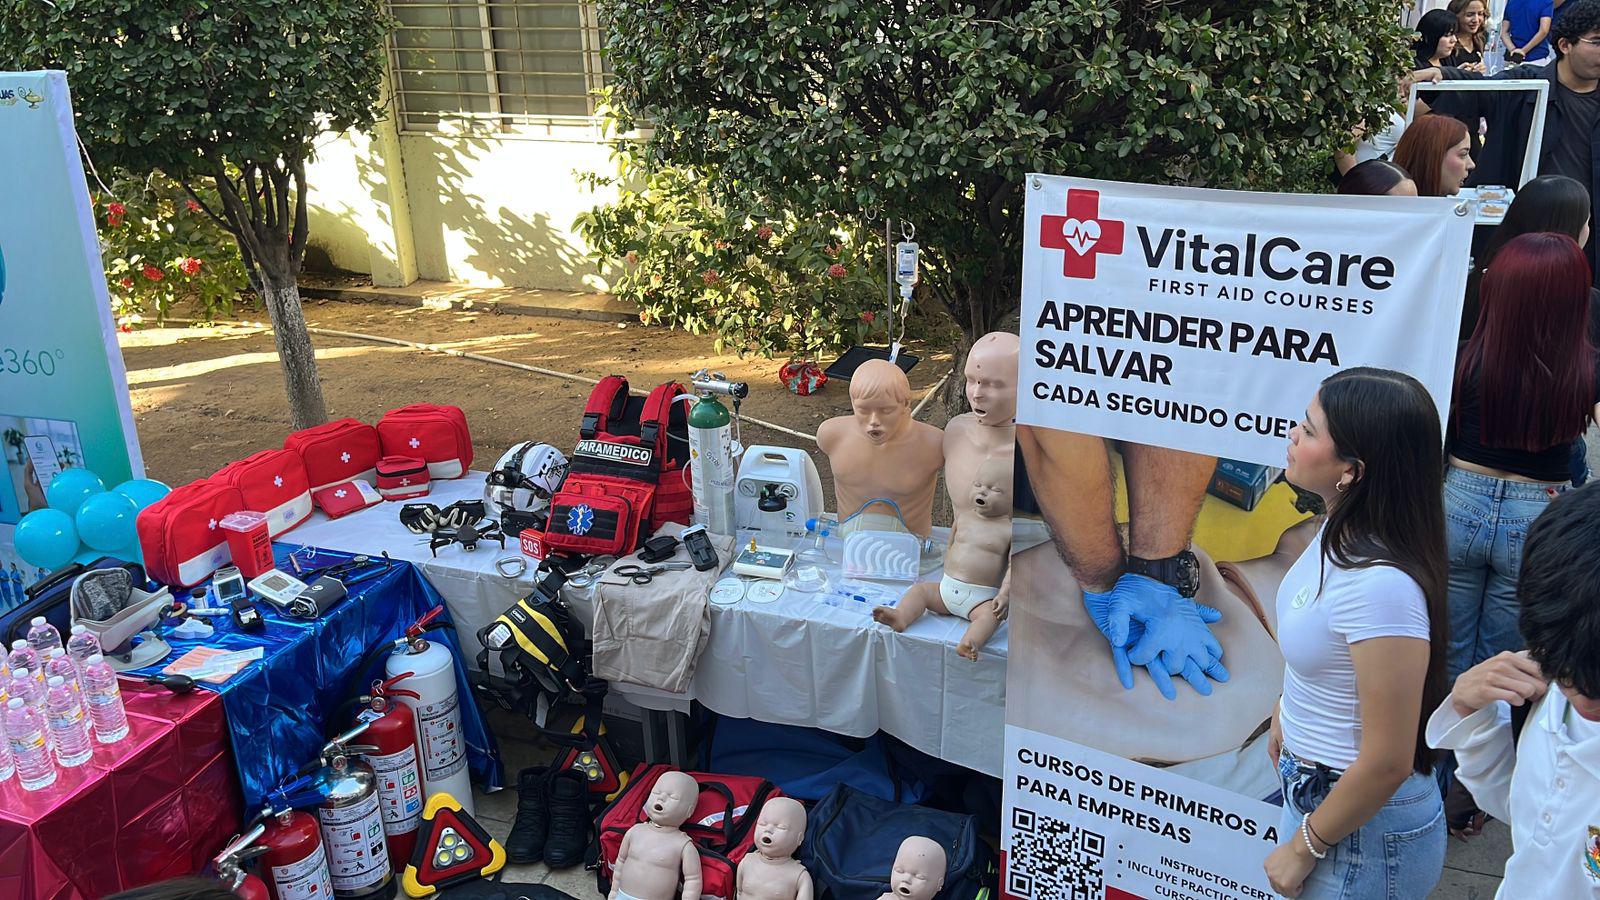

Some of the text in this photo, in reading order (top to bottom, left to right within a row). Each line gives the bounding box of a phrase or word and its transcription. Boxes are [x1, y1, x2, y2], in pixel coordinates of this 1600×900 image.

[1136, 225, 1395, 291] VitalCare
[1148, 278, 1374, 315] FIRST AID COURSES
[1036, 300, 1340, 367] APRENDER PARA
[1035, 339, 1173, 386] SALVAR
[1032, 381, 1101, 408] CADA
[1106, 392, 1228, 428] SEGUNDO
[576, 441, 649, 461] PARAMEDICO
[522, 538, 539, 554] SOS
[1016, 774, 1192, 845] PARA EMPRESAS
[1017, 748, 1104, 786] CURSOS
[1108, 774, 1136, 797] DE
[1141, 785, 1257, 836] PRIMEROS
[1127, 860, 1239, 900] INCLUYE PRACTIC
[1160, 855, 1238, 891] INSTRUCTOR
